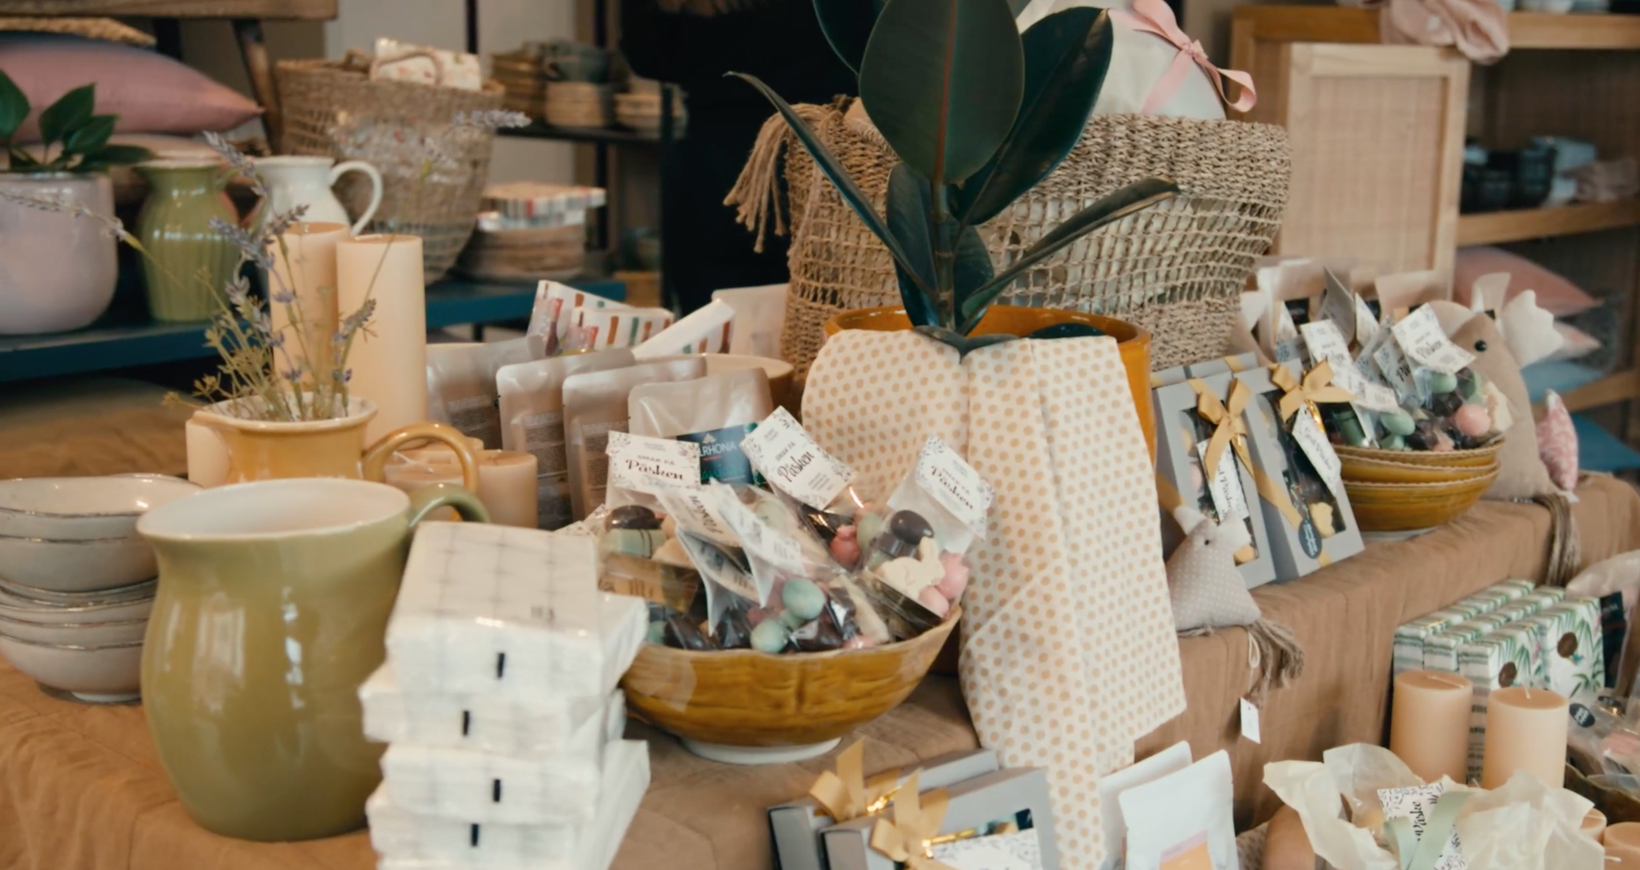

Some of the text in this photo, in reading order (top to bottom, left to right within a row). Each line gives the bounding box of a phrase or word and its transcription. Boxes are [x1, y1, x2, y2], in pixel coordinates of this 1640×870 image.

[699, 441, 738, 457] LRHONA
[625, 459, 684, 481] Påsken
[777, 451, 815, 483] Påsken
